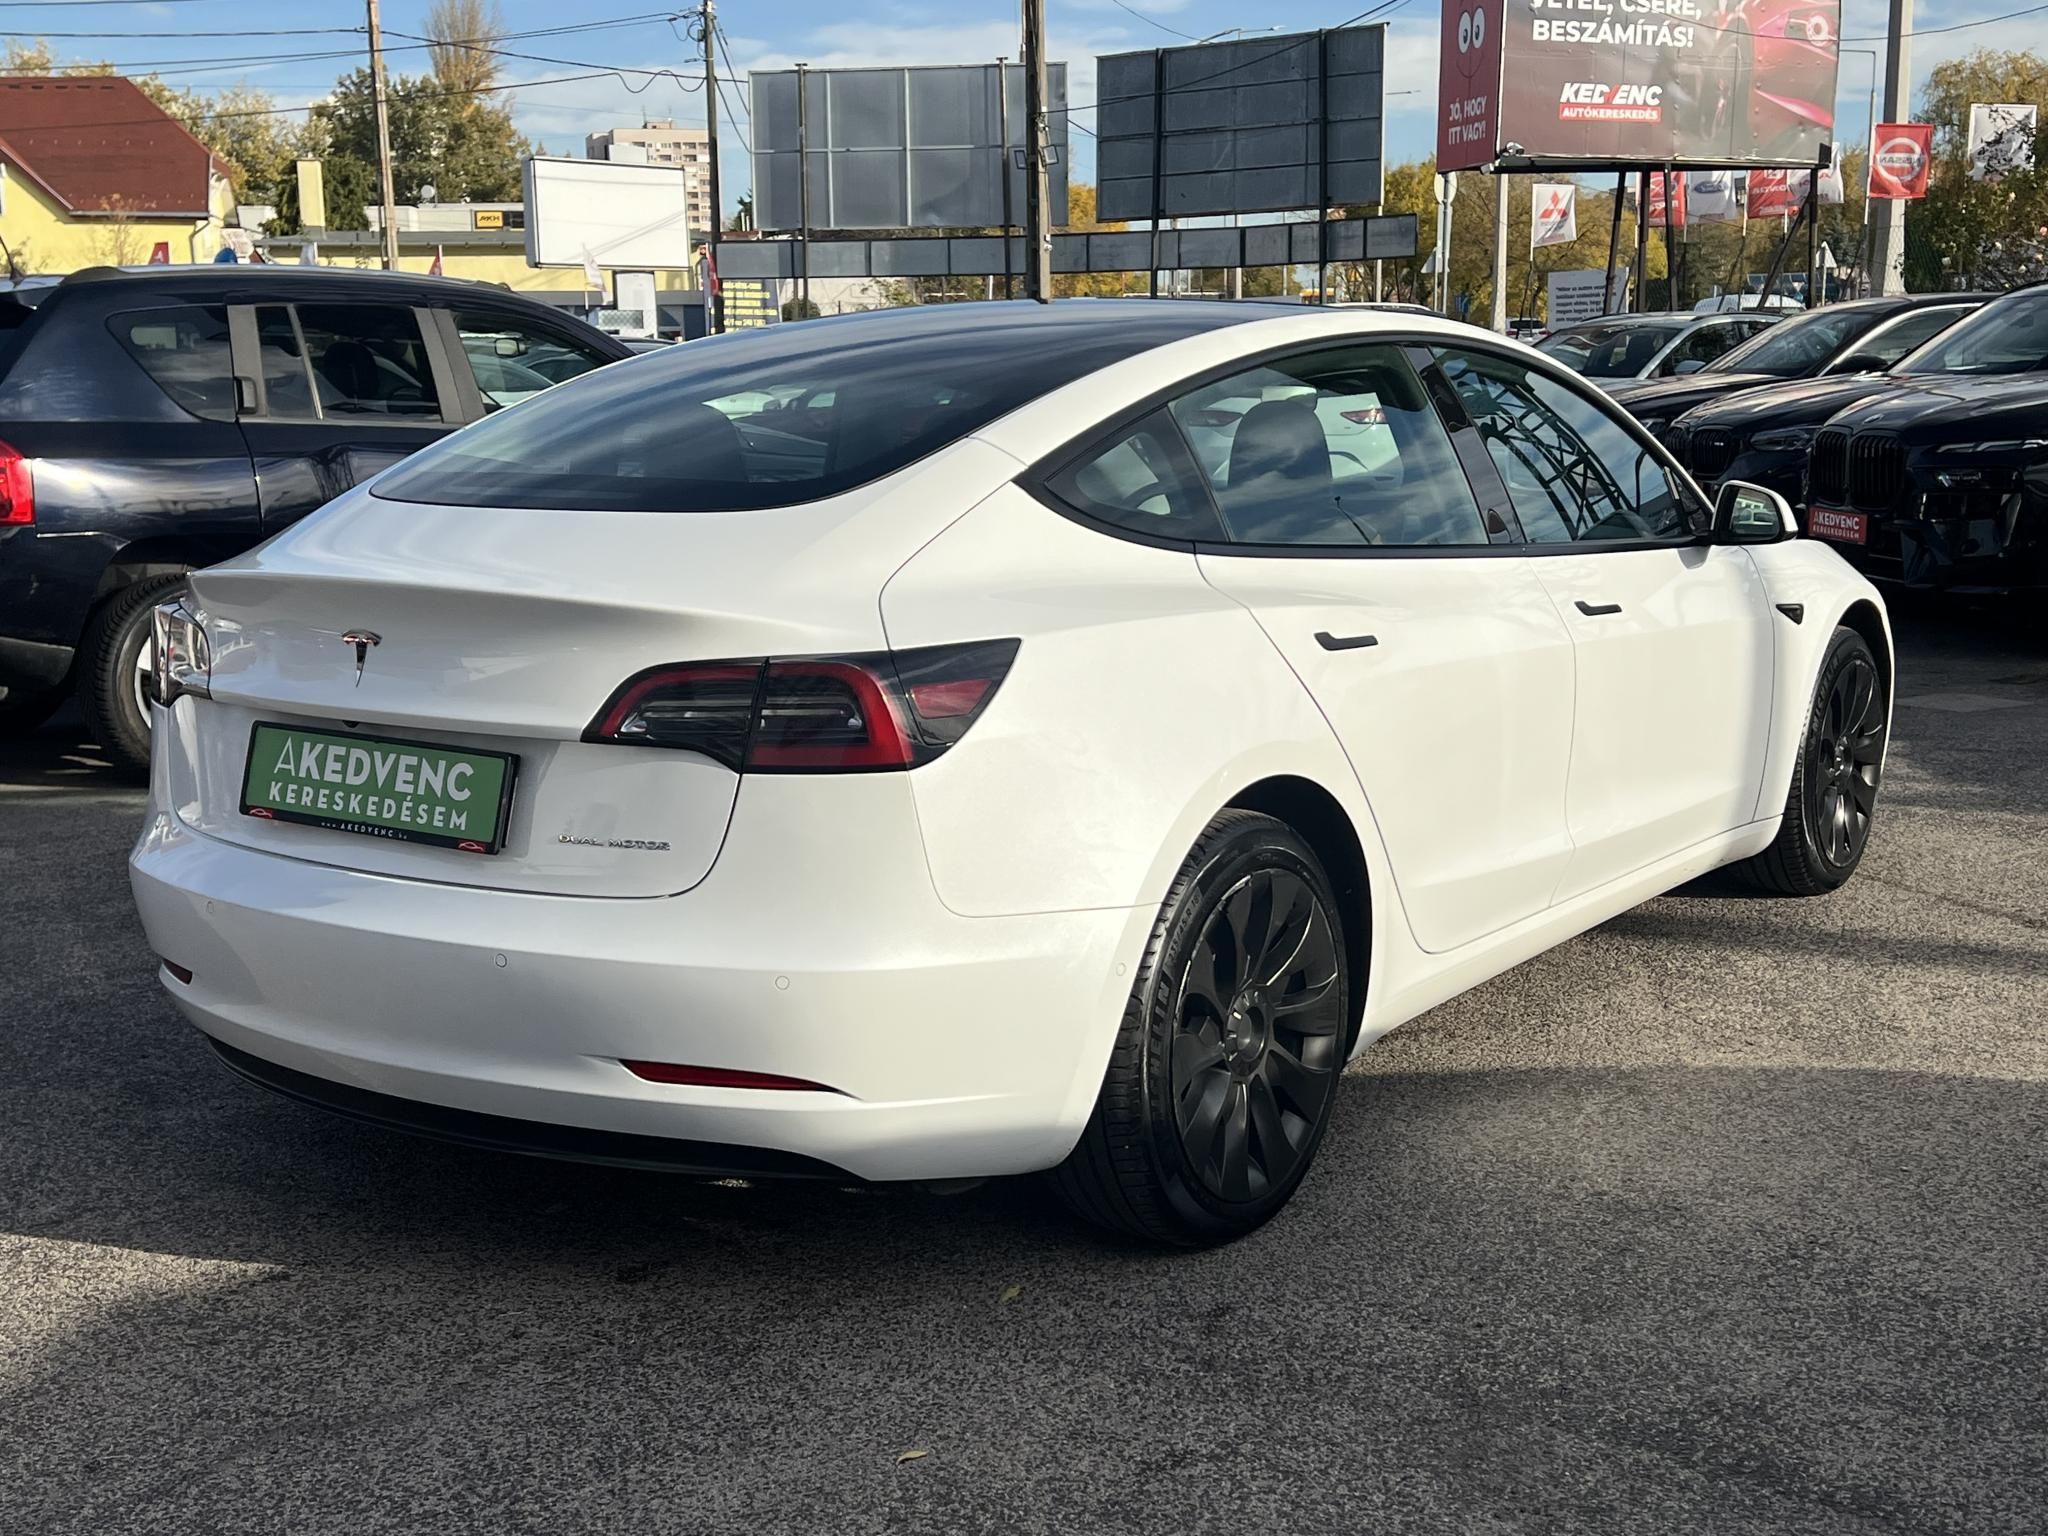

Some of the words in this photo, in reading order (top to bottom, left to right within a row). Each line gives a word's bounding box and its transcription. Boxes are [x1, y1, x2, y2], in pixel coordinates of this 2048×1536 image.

[1532, 17, 1694, 48] BESZÁMÍTÁS!
[1560, 83, 1663, 106] KEDVENC
[1449, 97, 1462, 123] JÓ,
[1464, 95, 1487, 118] HOGY
[1563, 107, 1659, 120] AUTÓKERESKEDÉS
[1449, 126, 1461, 145] ITT
[1462, 120, 1486, 142] VAGY!
[1813, 511, 1860, 530] AKEDVENC
[274, 736, 474, 801] AKEDVENC
[268, 781, 468, 831] KERESKEDÉSEM
[559, 834, 604, 847] DUAL
[608, 839, 671, 851] MOTOR
